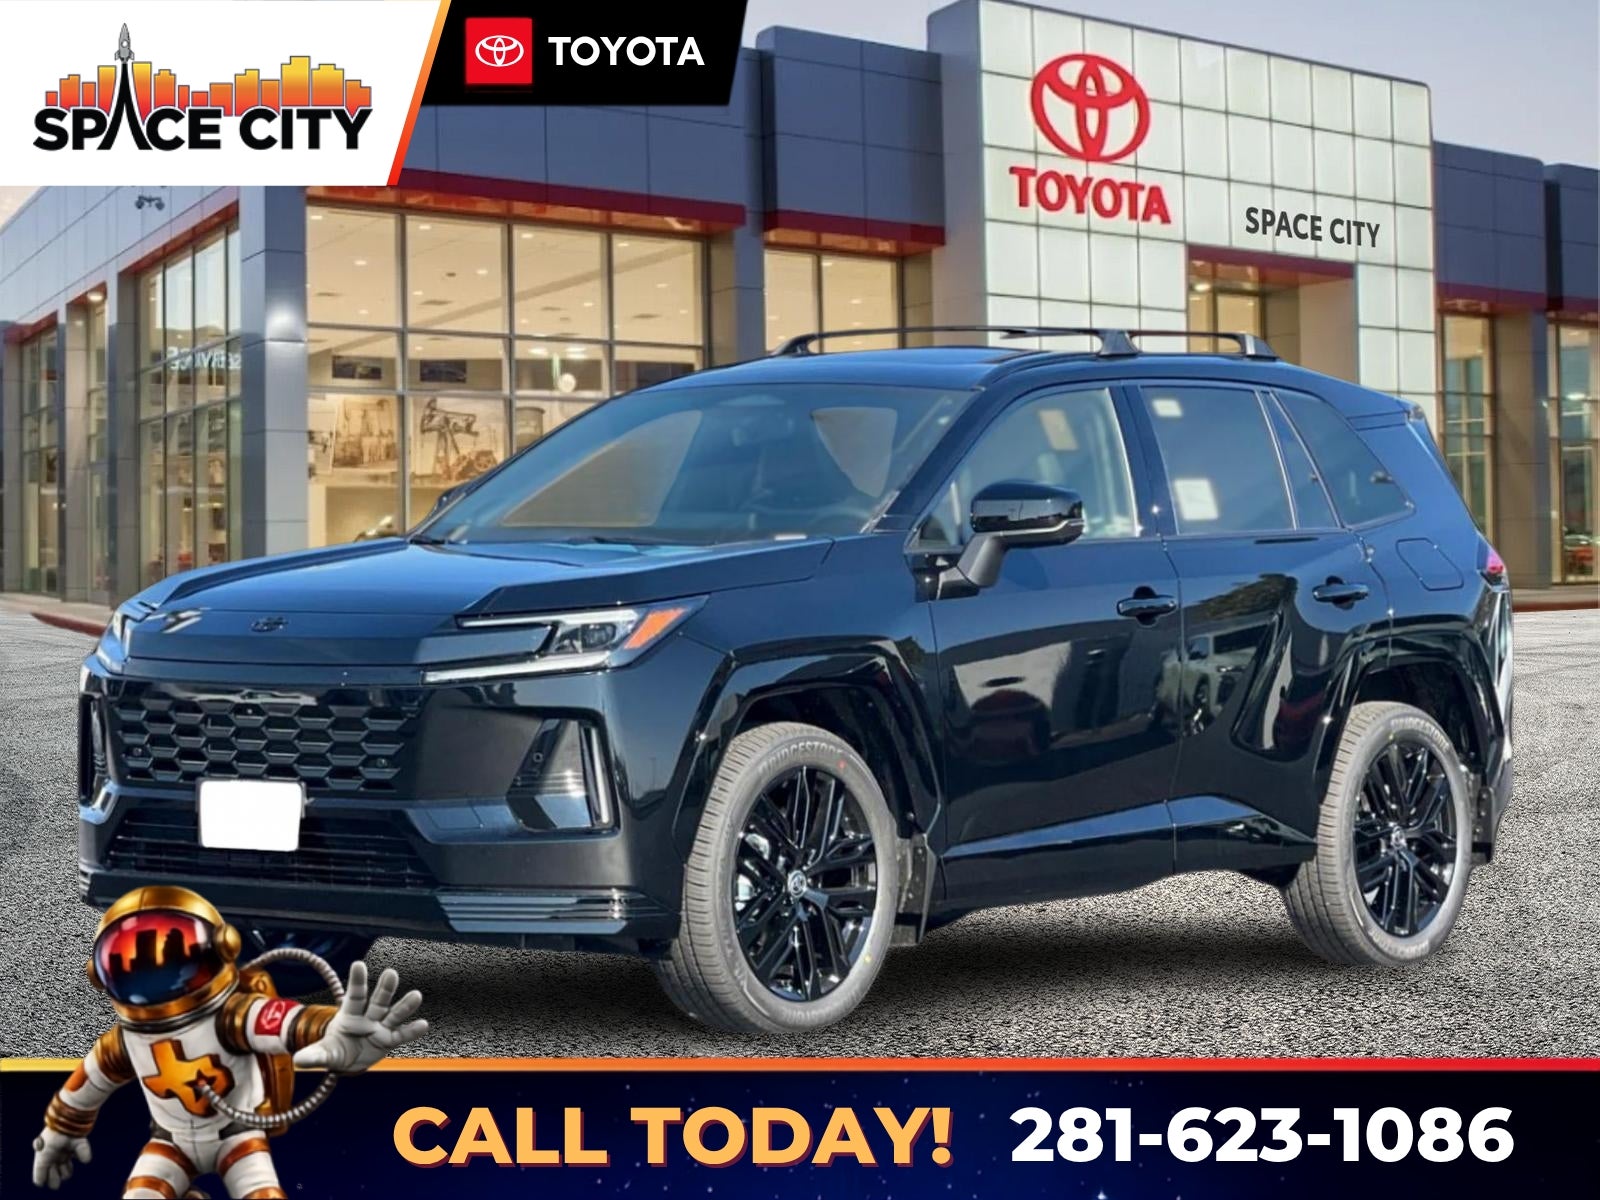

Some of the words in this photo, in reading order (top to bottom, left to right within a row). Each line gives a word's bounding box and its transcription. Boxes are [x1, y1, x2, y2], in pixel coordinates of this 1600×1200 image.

[1010, 165, 1172, 224] TOYOTA
[1245, 206, 1323, 242] SPACE
[1329, 218, 1381, 248] CITY
